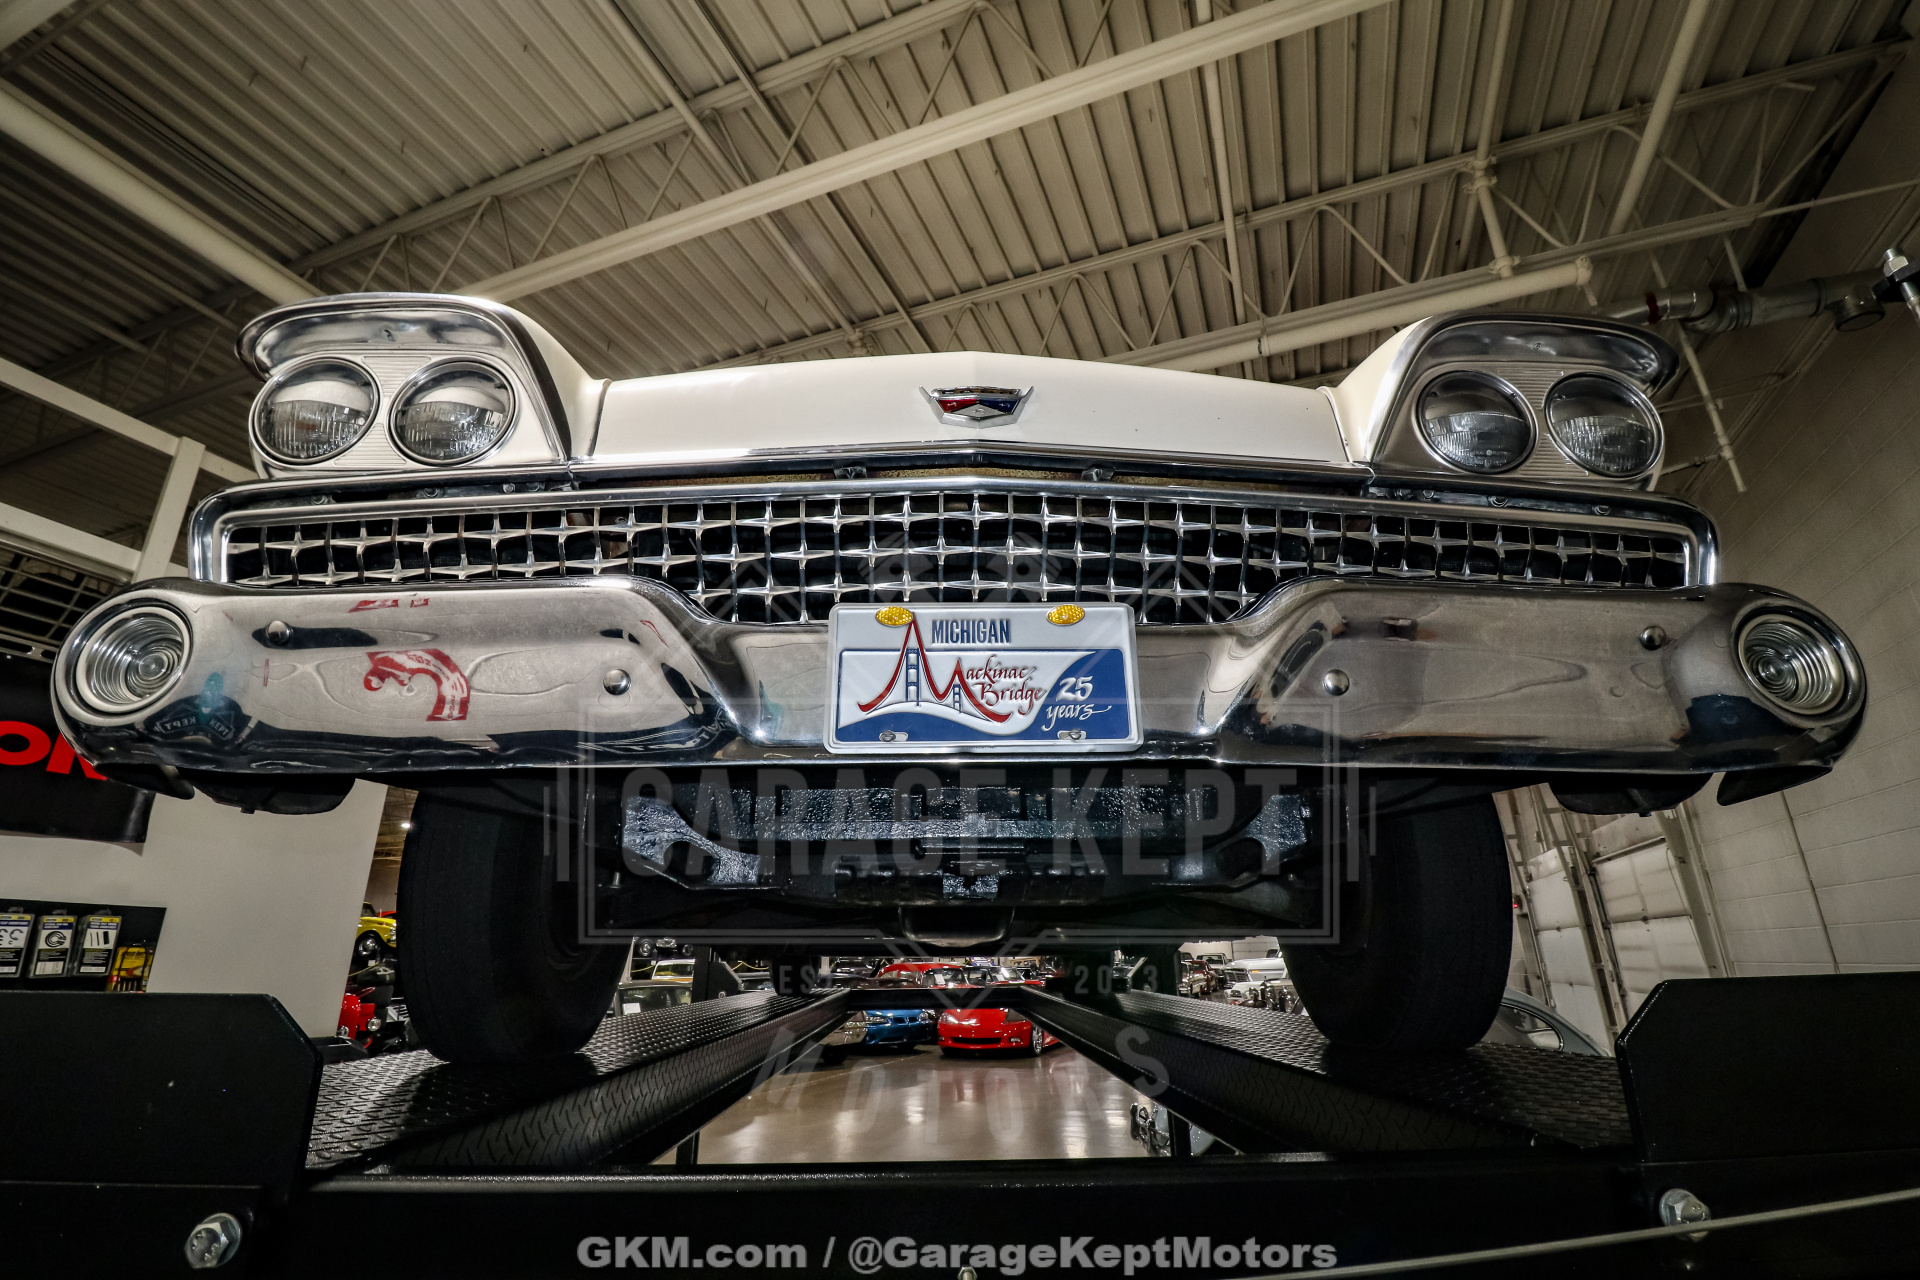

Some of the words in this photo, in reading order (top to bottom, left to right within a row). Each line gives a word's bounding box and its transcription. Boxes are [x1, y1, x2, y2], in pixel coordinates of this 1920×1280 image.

[931, 620, 1011, 645] MICHIGAN
[973, 677, 1048, 716] Bridge
[1055, 675, 1094, 702] 25
[1041, 702, 1112, 732] years
